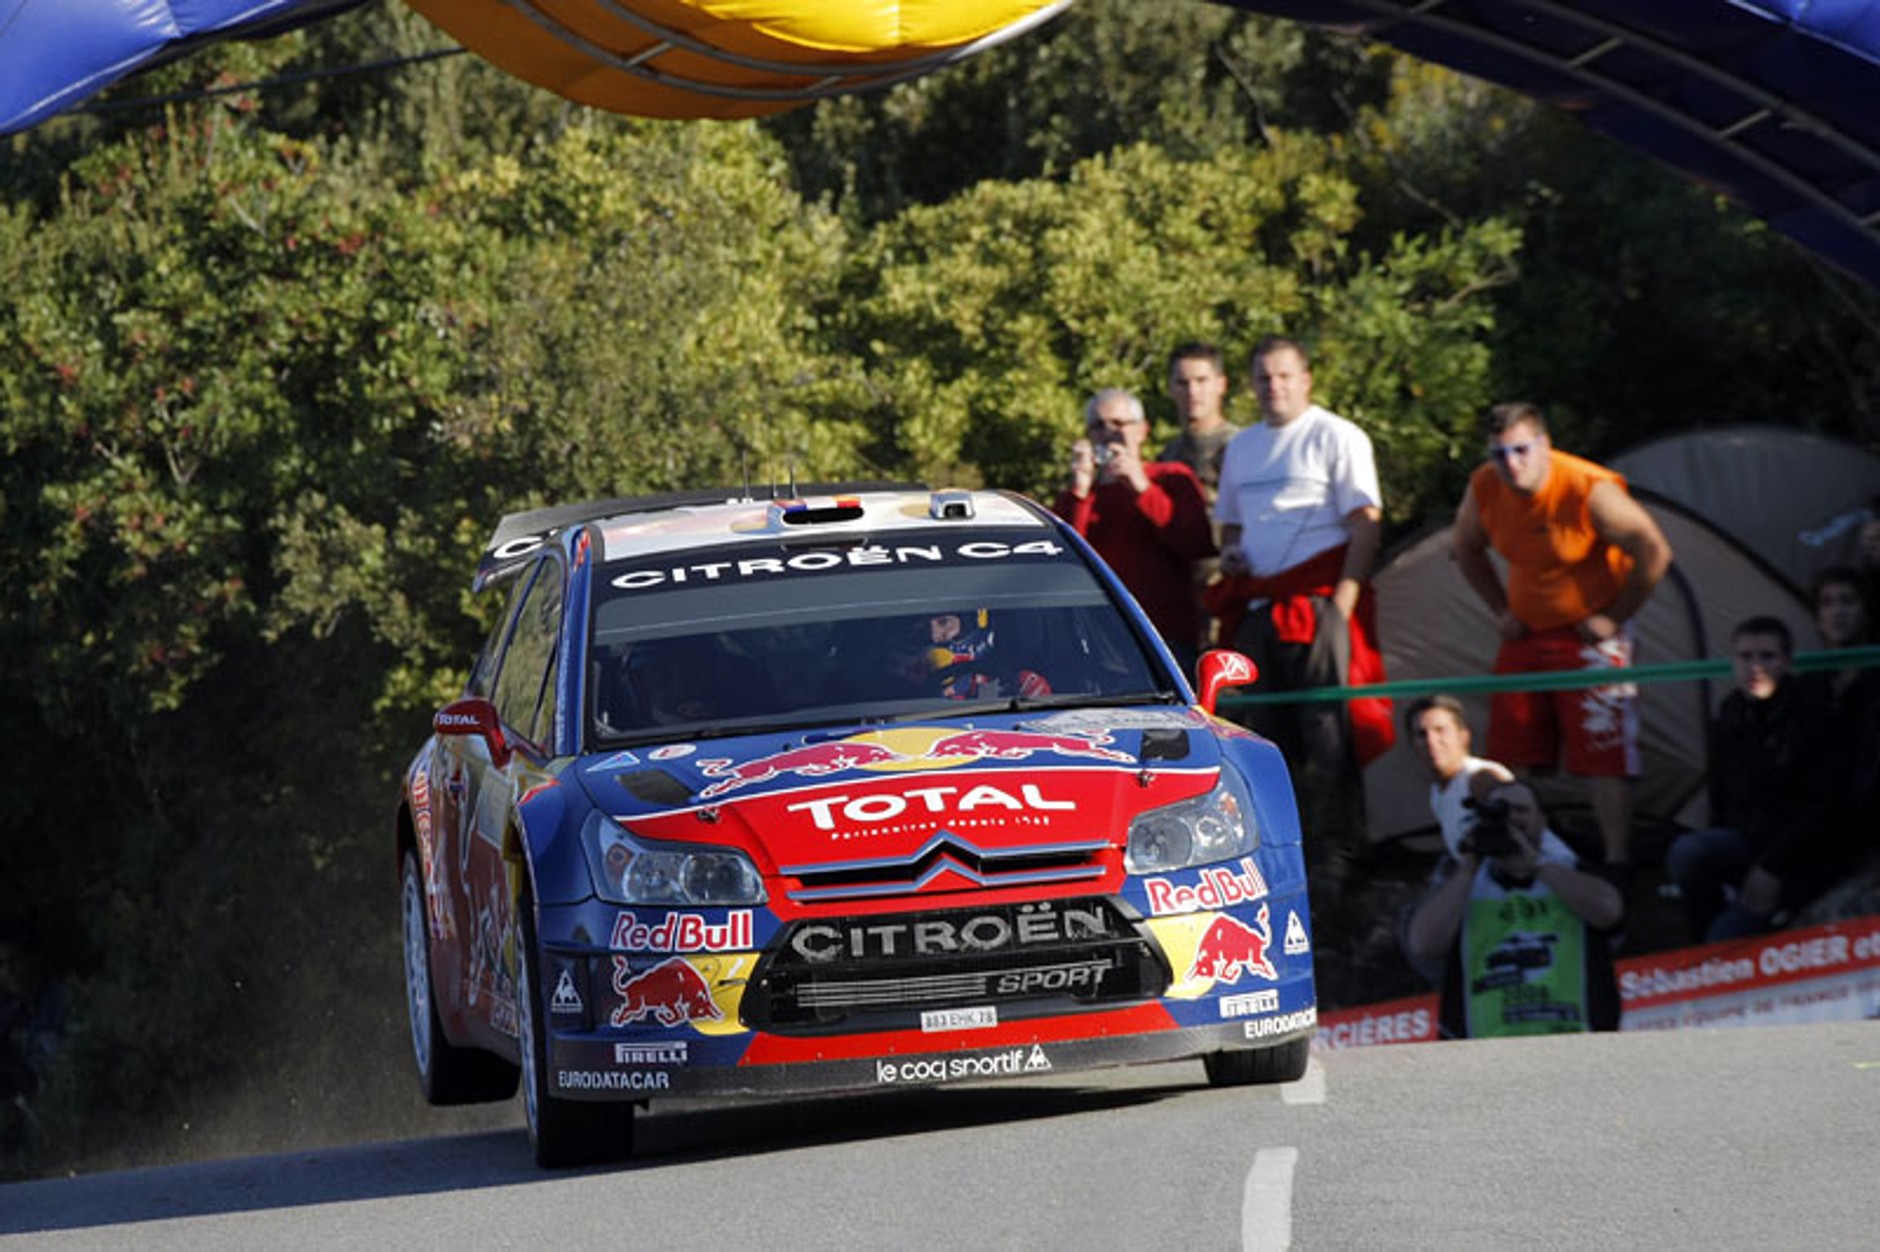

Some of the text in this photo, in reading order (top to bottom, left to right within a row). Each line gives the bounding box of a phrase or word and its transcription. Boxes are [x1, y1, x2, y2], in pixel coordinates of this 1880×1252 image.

[611, 540, 1063, 588] CITROËN C4
[438, 714, 481, 725] TOTAL
[787, 784, 1077, 830] TOTAL
[1144, 857, 1268, 916] Red Bull
[610, 909, 753, 951] Red Bull
[791, 901, 1108, 963] CITROËN
[1759, 935, 1850, 976] OGIER
[997, 963, 1113, 994] SPORT
[1311, 1008, 1431, 1049] RCIÈRES
[615, 1041, 687, 1064] PIRELLI
[876, 1049, 1024, 1083] le coq sportif
[558, 1069, 670, 1089] EURODATACAR
